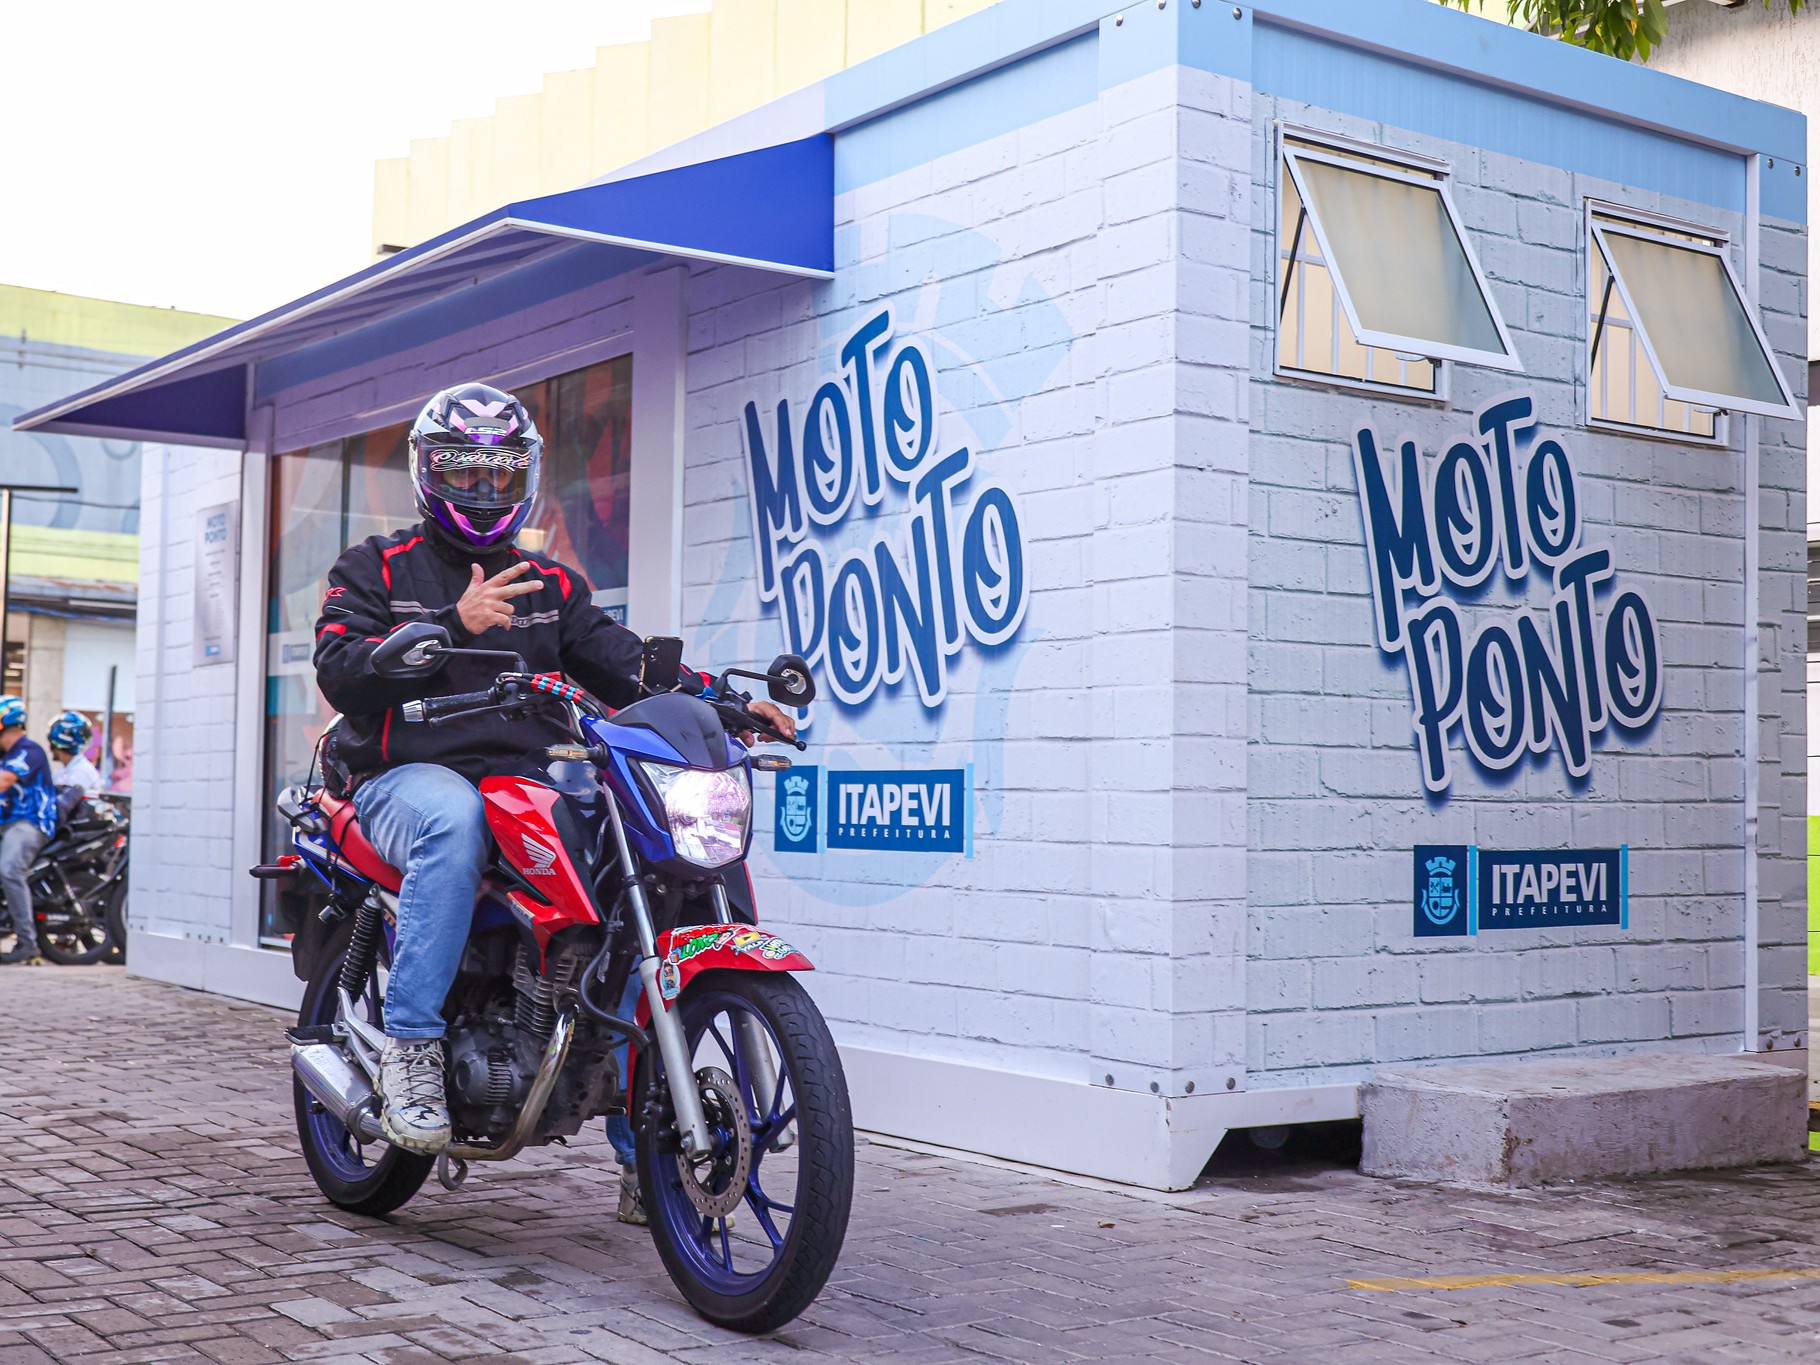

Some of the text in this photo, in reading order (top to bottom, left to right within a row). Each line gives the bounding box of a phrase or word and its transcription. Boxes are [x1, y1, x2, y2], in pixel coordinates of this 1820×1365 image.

[464, 426, 507, 437] LS2
[745, 310, 933, 592] MOTO
[1357, 396, 1577, 643] MOTO
[780, 446, 1023, 722] PONTO
[1407, 549, 1658, 782] PONTO
[838, 783, 951, 827] ITAPEVI
[838, 827, 951, 839] PREFEITURA
[522, 867, 557, 876] HONDA
[1492, 862, 1607, 904] ITAPEVI
[1492, 904, 1607, 917] PREFEITURA
